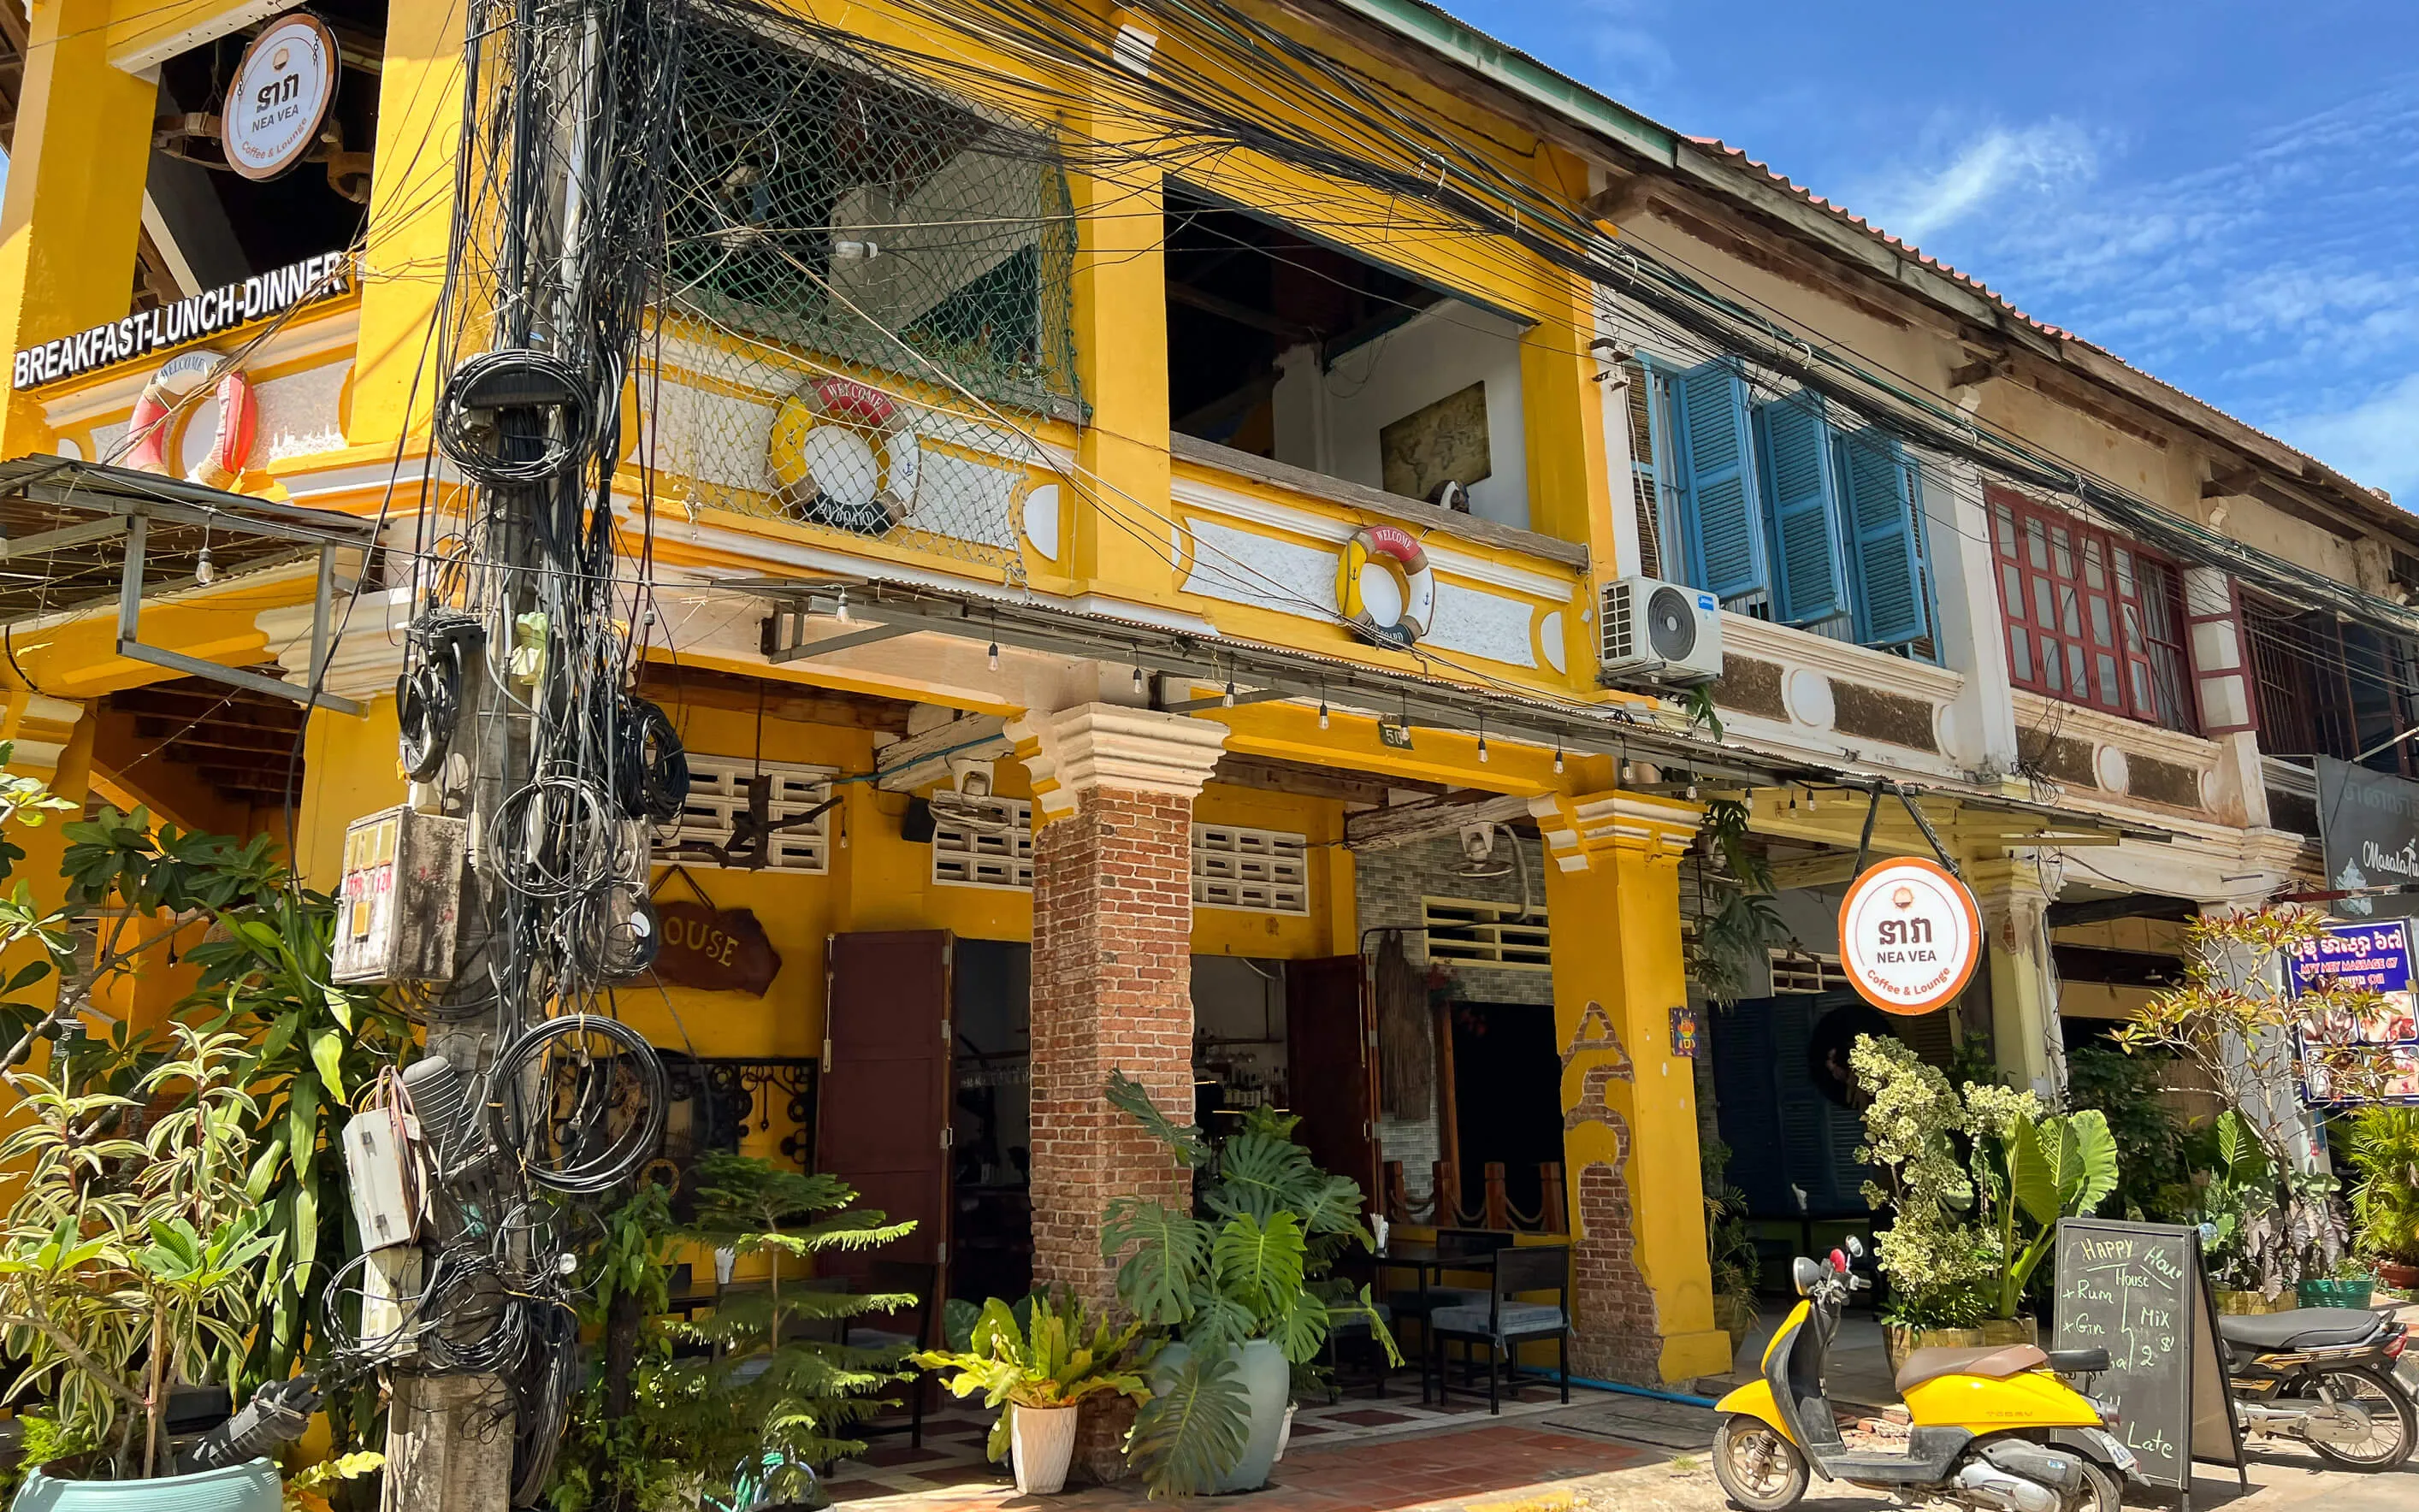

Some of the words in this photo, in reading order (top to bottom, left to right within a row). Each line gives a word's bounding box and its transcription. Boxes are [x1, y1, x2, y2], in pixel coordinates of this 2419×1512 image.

[252, 115, 274, 133] NEA
[278, 104, 299, 121] VEA
[241, 140, 266, 159] Coffee
[268, 148, 275, 158] &
[275, 117, 307, 153] Lounge
[160, 355, 206, 380] WELCOME
[826, 382, 884, 408] WELCOME
[1375, 529, 1412, 551] WELCOME
[2363, 840, 2408, 875] Masala
[659, 916, 740, 967] OUSE
[1877, 952, 1905, 964] NEA
[1908, 950, 1937, 962] VEA
[2321, 960, 2341, 973] MEY
[2342, 958, 2385, 972] MASSAGE
[2386, 957, 2398, 970] 67
[1867, 969, 1901, 995] Coffee
[1903, 986, 1912, 995] &
[1913, 967, 1950, 995] Lounge
[2080, 1237, 2133, 1261] HAPPY
[2115, 1267, 2150, 1287] House
[2127, 1420, 2174, 1459] Late
